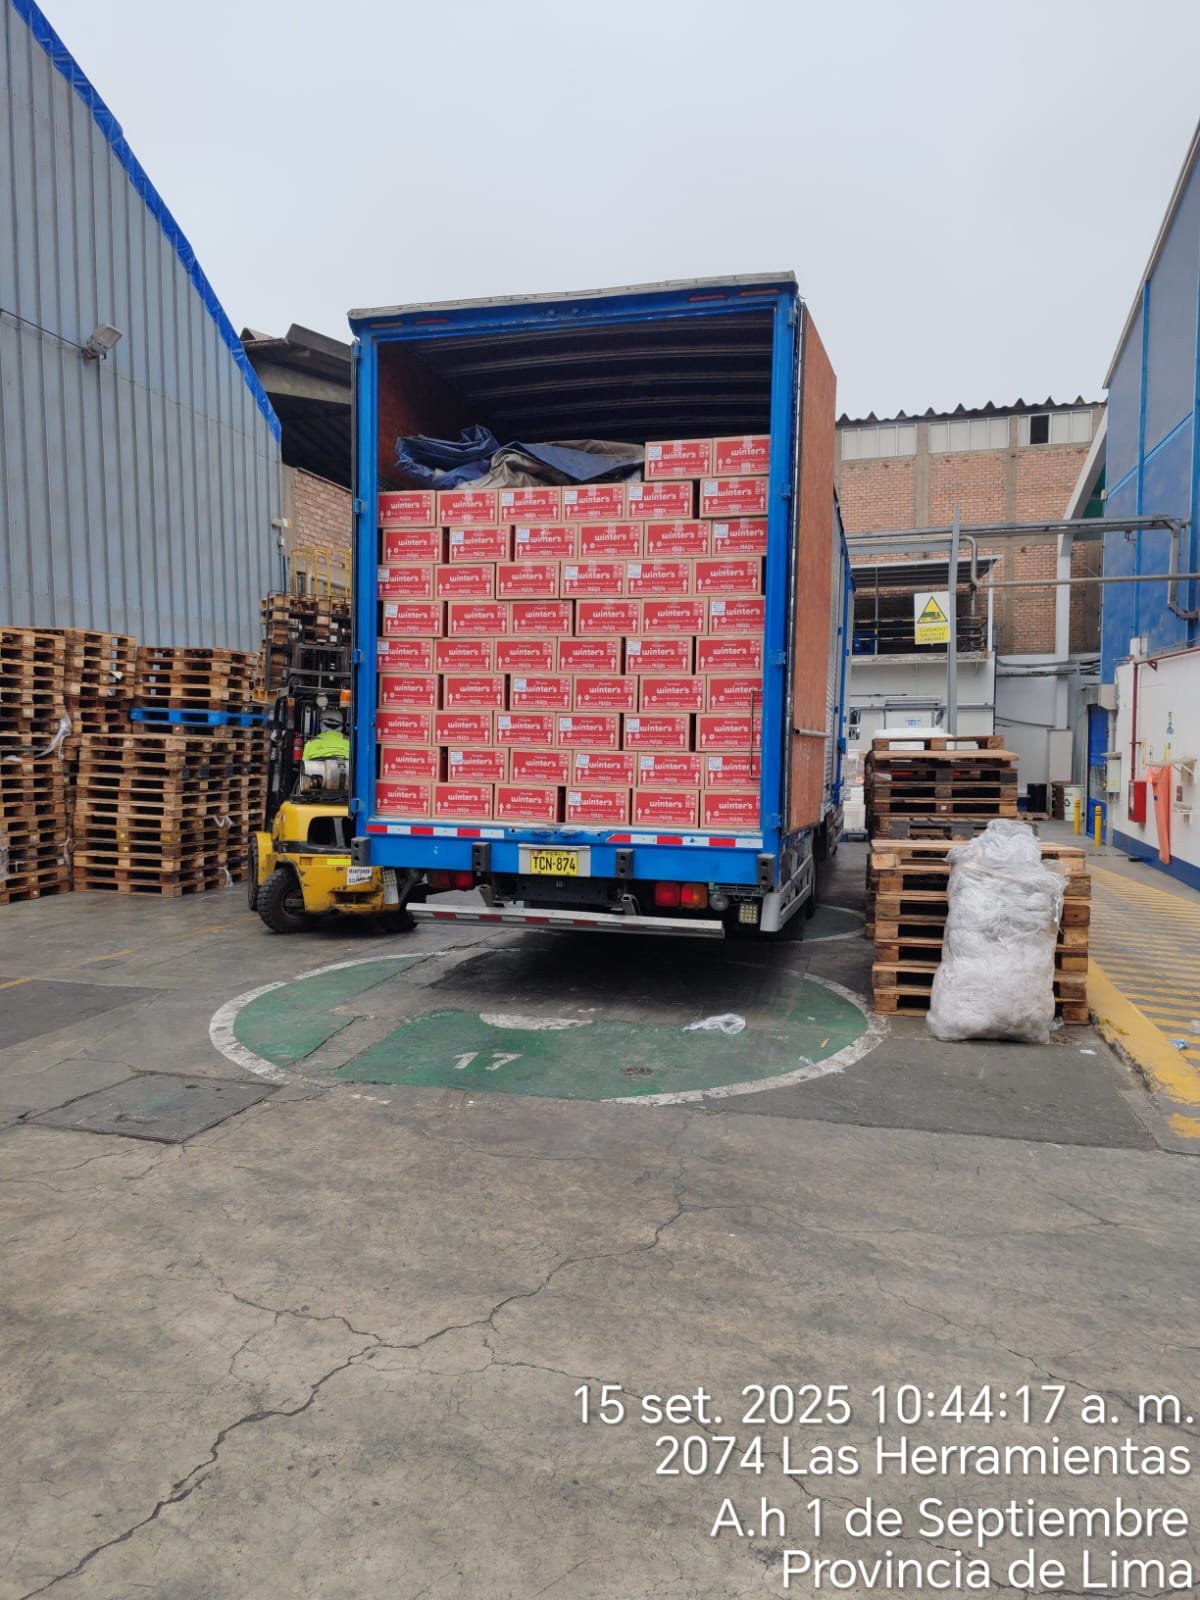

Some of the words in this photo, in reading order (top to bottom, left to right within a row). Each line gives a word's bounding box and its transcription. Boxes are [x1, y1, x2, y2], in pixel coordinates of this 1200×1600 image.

[662, 451, 697, 460] winter's
[731, 447, 766, 456] winter's
[643, 492, 677, 501] winter's
[717, 488, 752, 497] winter's
[515, 497, 546, 506] winter's
[577, 495, 610, 503] winter's
[390, 501, 420, 509] winter's
[452, 499, 483, 508] winter's
[594, 532, 627, 541] winter's
[661, 530, 695, 539] winter's
[729, 528, 764, 537] winter's
[398, 538, 428, 546] winter's
[464, 536, 494, 544] winter's
[530, 534, 562, 543] winter's
[511, 572, 543, 580] winter's
[577, 571, 610, 579] winter's
[642, 570, 675, 578] winter's
[710, 568, 744, 577] winter's
[389, 574, 419, 582] winter's
[449, 573, 479, 582] winter's
[398, 611, 428, 619] winter's
[464, 611, 495, 619] winter's
[525, 610, 557, 618] winter's
[592, 610, 625, 618] winter's
[657, 609, 690, 617] winter's
[726, 607, 760, 616] winter's
[389, 648, 419, 656] winter's
[448, 648, 479, 656] winter's
[509, 648, 540, 656] winter's
[572, 648, 605, 656] winter's
[642, 647, 675, 656] winter's
[712, 646, 747, 655] winter's
[394, 684, 424, 692] winter's
[459, 684, 490, 693] winter's
[526, 684, 558, 693] winter's
[589, 685, 621, 694] winter's
[656, 686, 690, 694] winter's
[388, 719, 418, 728] winter's
[447, 720, 478, 728] winter's
[571, 723, 603, 731] winter's
[639, 724, 673, 732] winter's
[714, 724, 748, 733] winter's
[395, 755, 425, 764] winter's
[525, 759, 556, 767] winter's
[589, 761, 621, 769] winter's
[654, 762, 688, 770] winter's
[387, 790, 417, 799] winter's
[447, 792, 478, 801] winter's
[511, 794, 542, 803] winter's
[581, 797, 613, 806] winter's
[649, 800, 682, 808] winter's
[718, 801, 753, 809] winter's
[533, 856, 575, 872] TCN-874
[453, 1052, 522, 1071] 17
